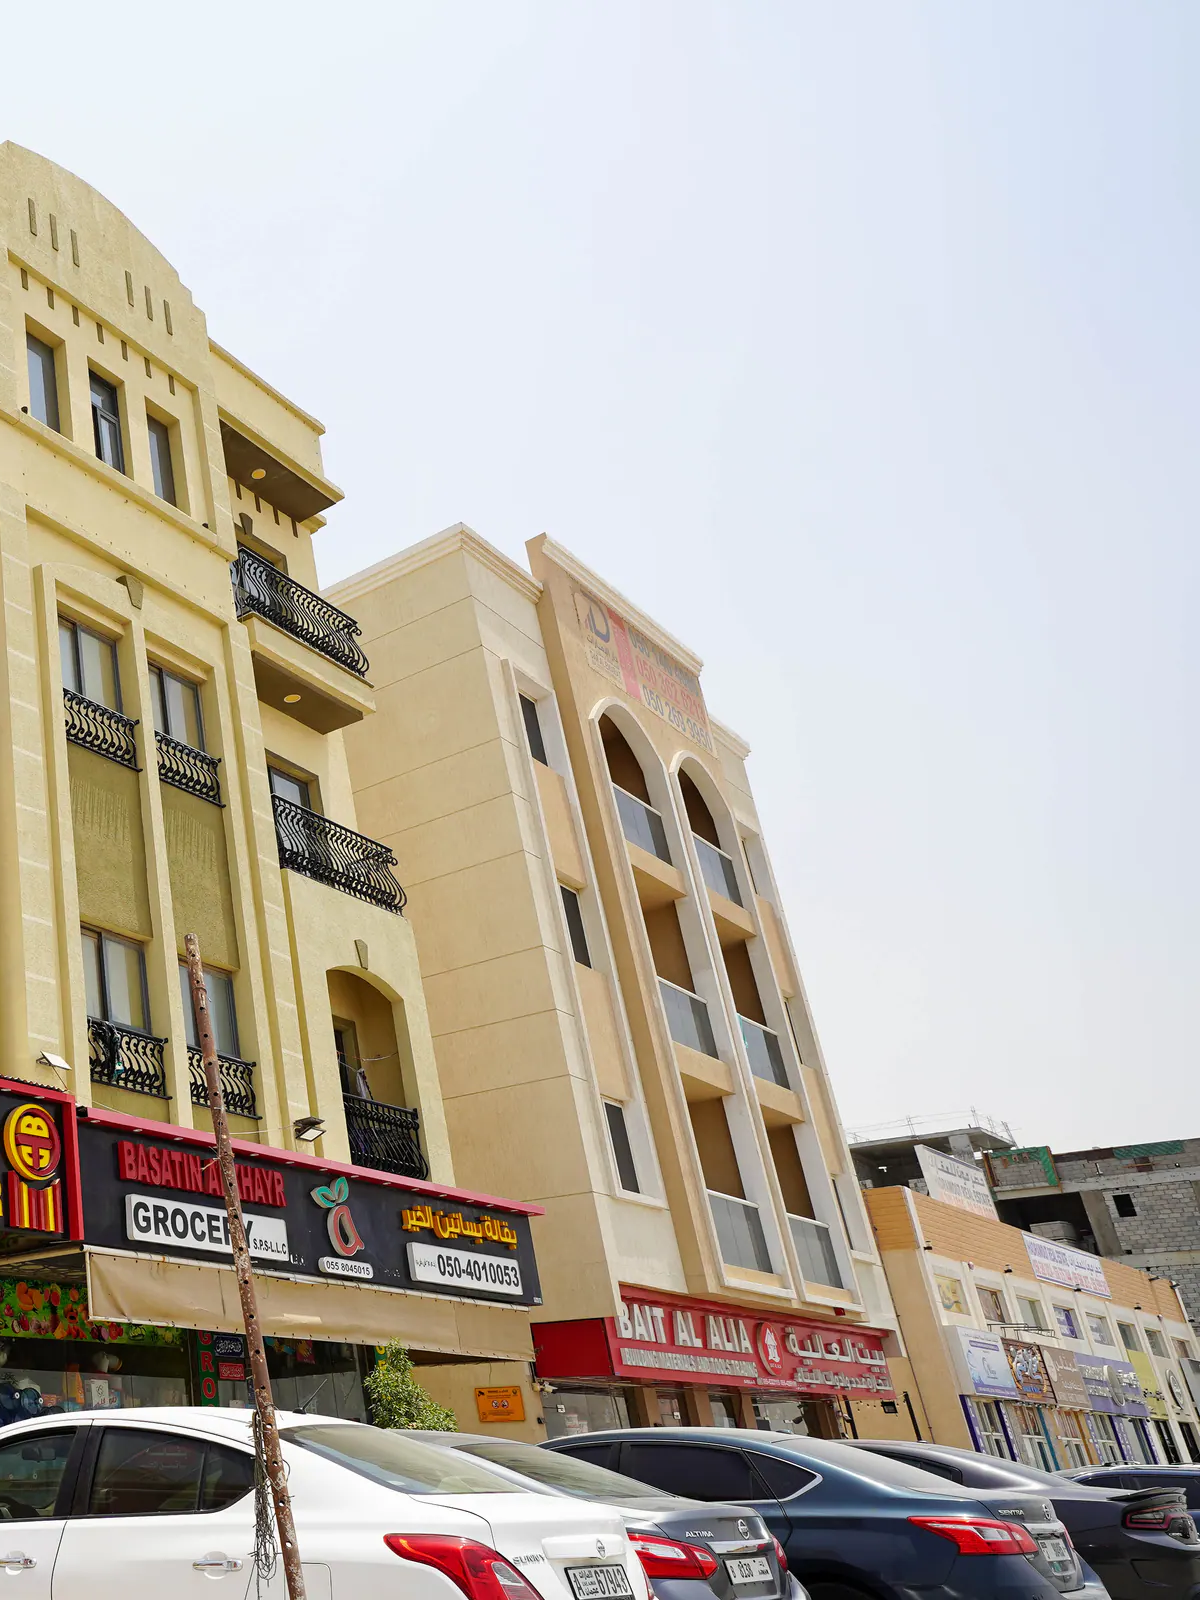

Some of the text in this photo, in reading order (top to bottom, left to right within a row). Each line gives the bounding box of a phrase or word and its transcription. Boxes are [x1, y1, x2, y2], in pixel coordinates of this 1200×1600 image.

[642, 683, 664, 717] 050
[117, 1140, 204, 1193] BASATIN
[401, 1205, 518, 1250] بقالة بساتين الخير
[326, 1260, 340, 1271] 055
[341, 1262, 371, 1276] 8045015
[437, 1253, 520, 1288] 050-4010053
[616, 1300, 754, 1354] BAIT AL ALIA
[785, 1326, 856, 1366] العالية
[198, 1330, 217, 1407] GRO
[685, 1530, 714, 1539] ALTIMA
[512, 1554, 545, 1565] SUNNY
[573, 1568, 629, 1597] A 67943
